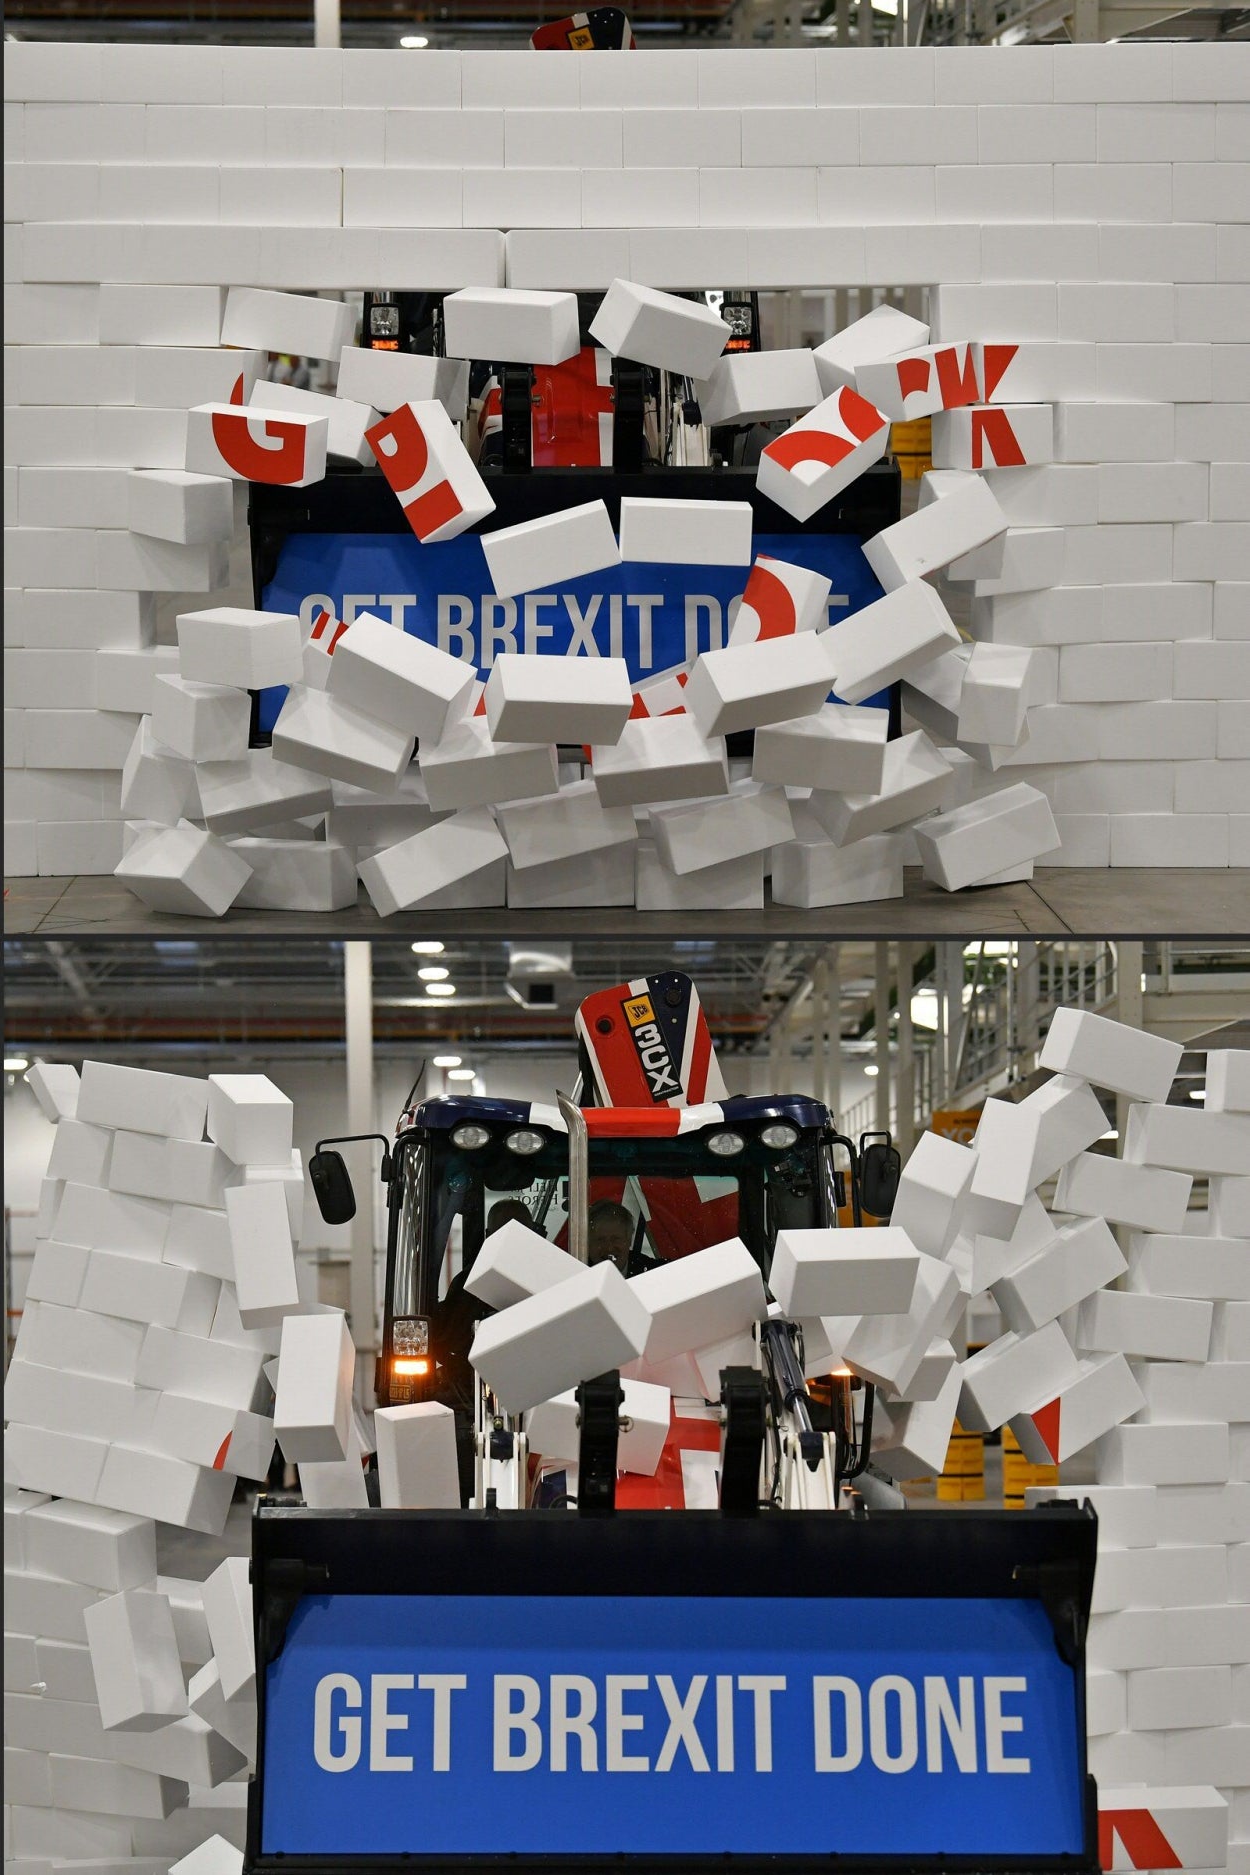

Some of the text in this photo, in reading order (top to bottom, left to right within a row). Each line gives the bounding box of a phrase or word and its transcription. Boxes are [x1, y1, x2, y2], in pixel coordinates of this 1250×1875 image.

[635, 1023, 679, 1092] 3CX
[313, 1673, 1031, 1774] GET BREXIT DONE
